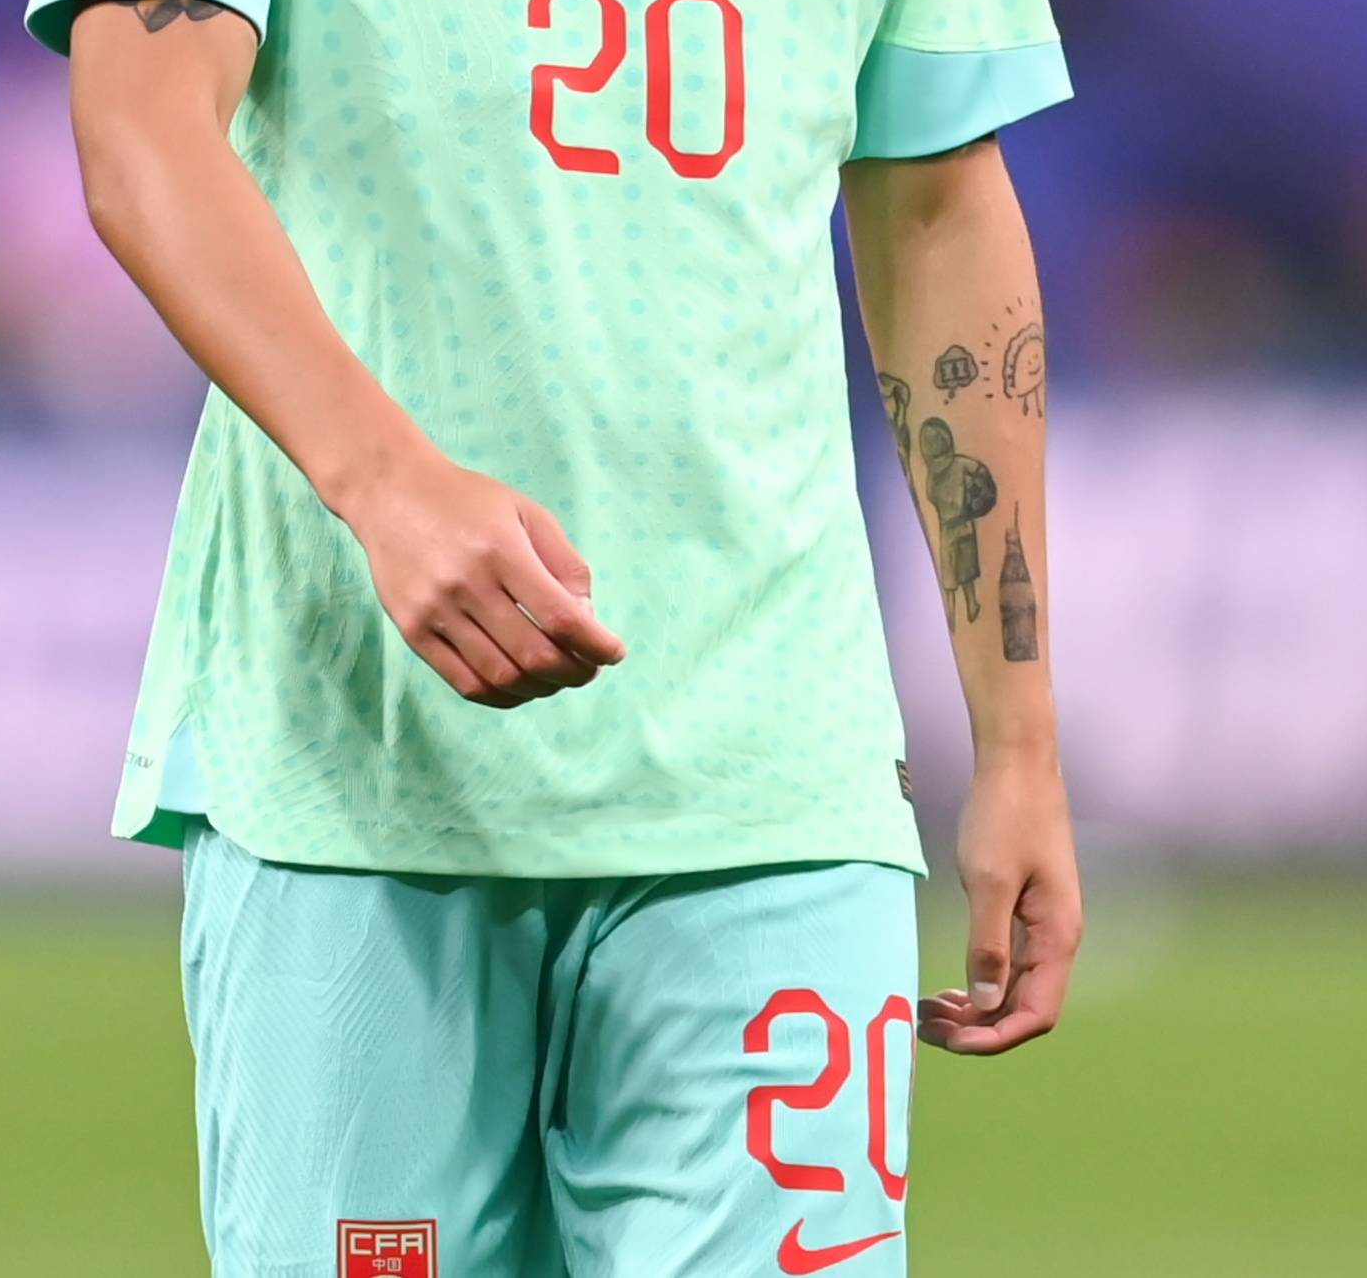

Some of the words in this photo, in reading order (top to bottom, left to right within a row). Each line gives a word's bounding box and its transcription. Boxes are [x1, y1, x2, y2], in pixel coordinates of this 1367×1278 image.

[743, 988, 917, 1202] 20
[349, 1232, 424, 1256] CFA
[372, 1257, 402, 1272] 中国
